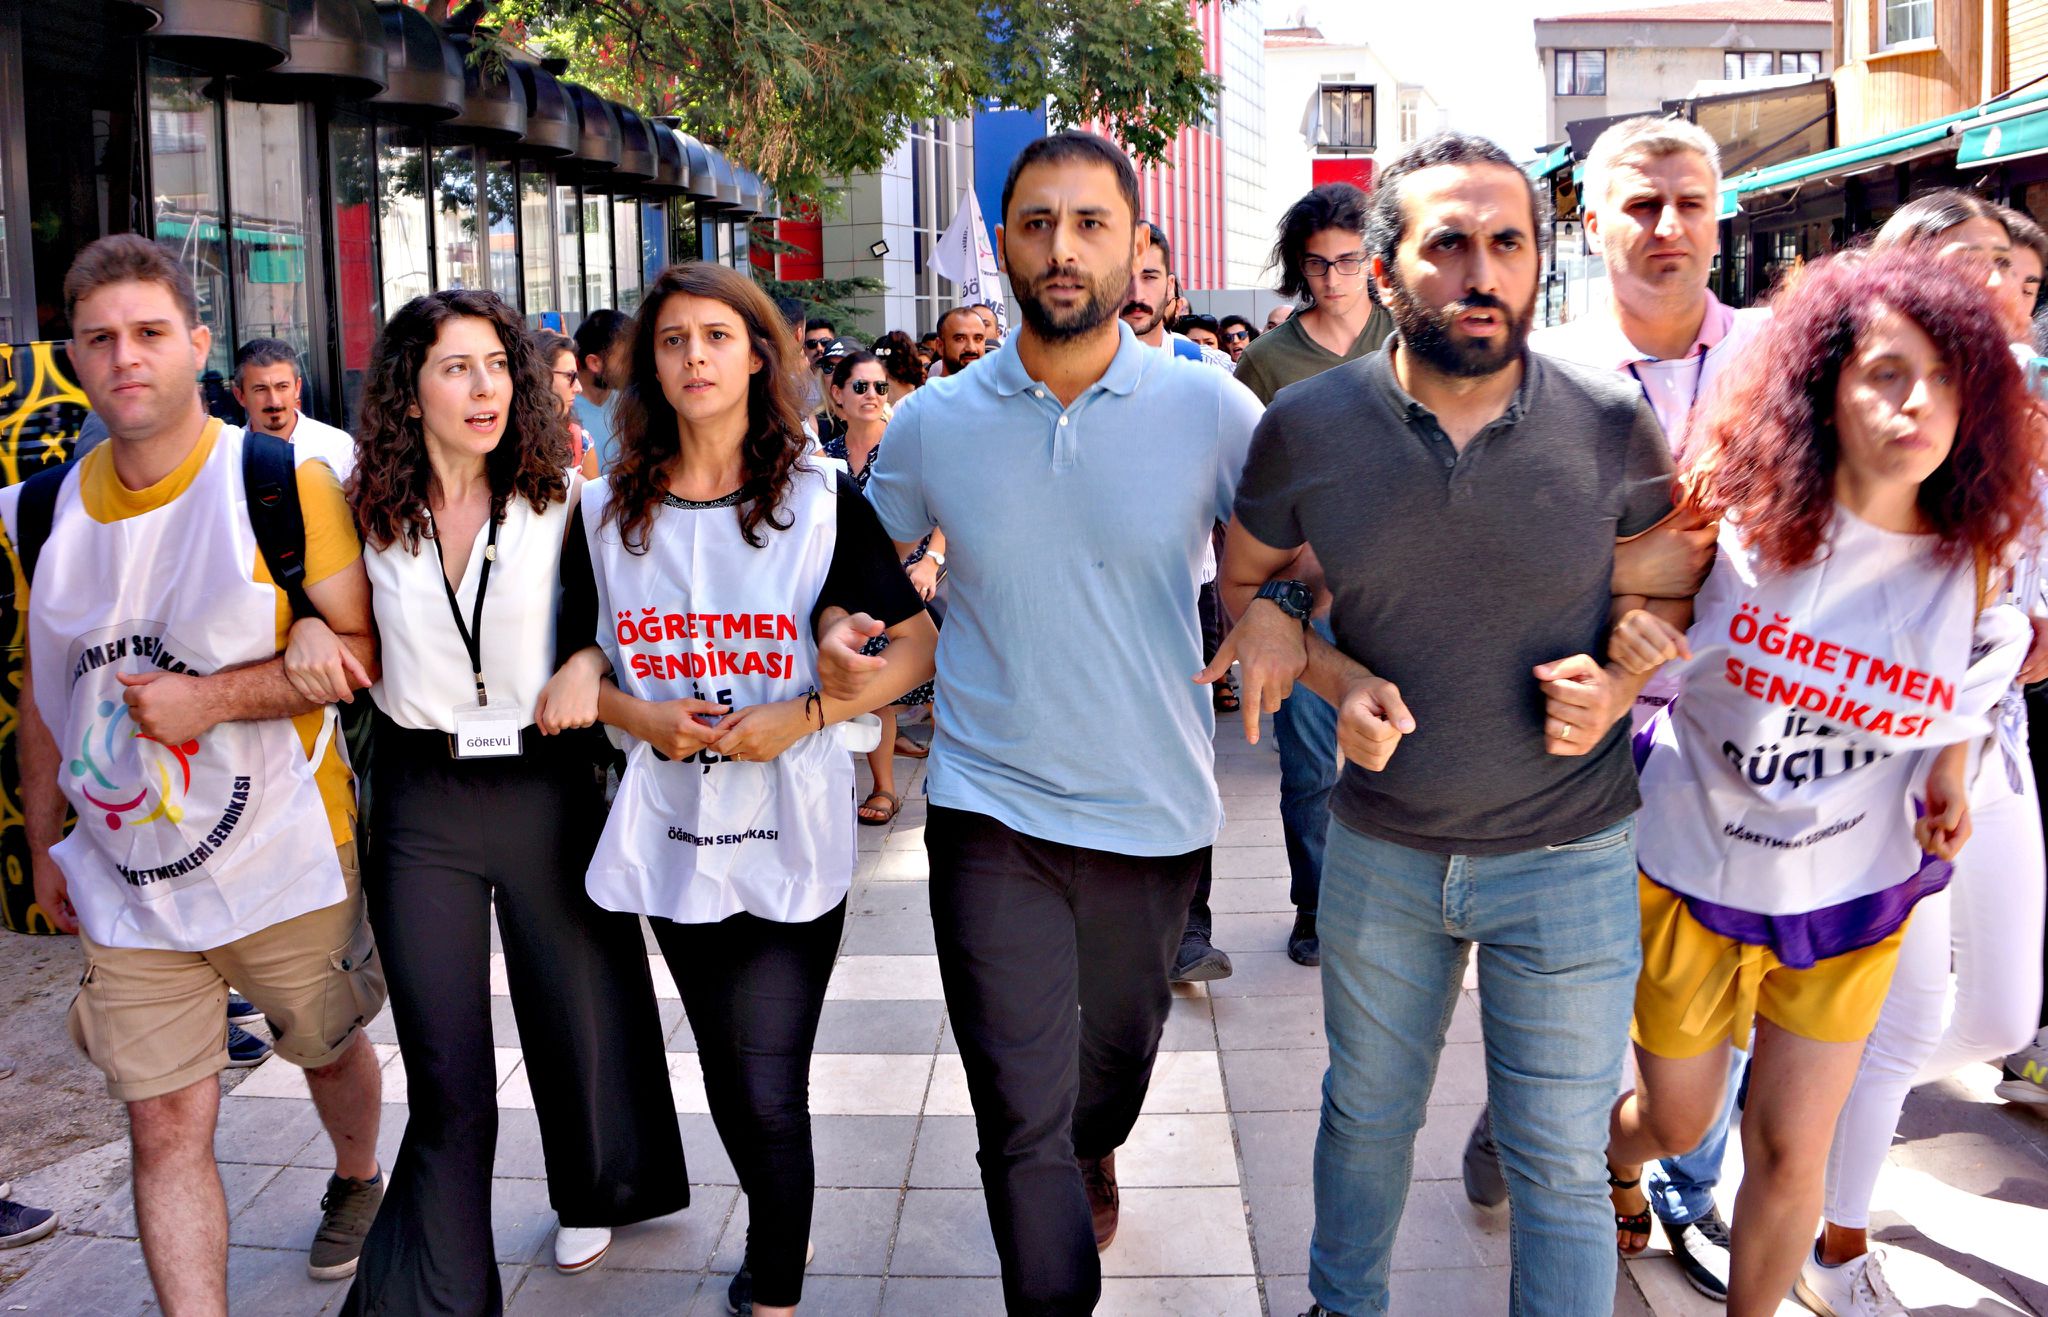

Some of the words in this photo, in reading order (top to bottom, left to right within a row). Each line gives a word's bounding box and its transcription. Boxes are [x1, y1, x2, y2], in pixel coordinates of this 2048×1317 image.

[617, 606, 798, 645] ÖĞRETMEN
[630, 641, 794, 680] SENDİKASI
[1729, 602, 1956, 711] ÖĞRETMEN
[1725, 657, 1936, 737] SENDİKASI
[466, 736, 511, 748] GÖREVLİ
[206, 776, 251, 848] SENDİKASI
